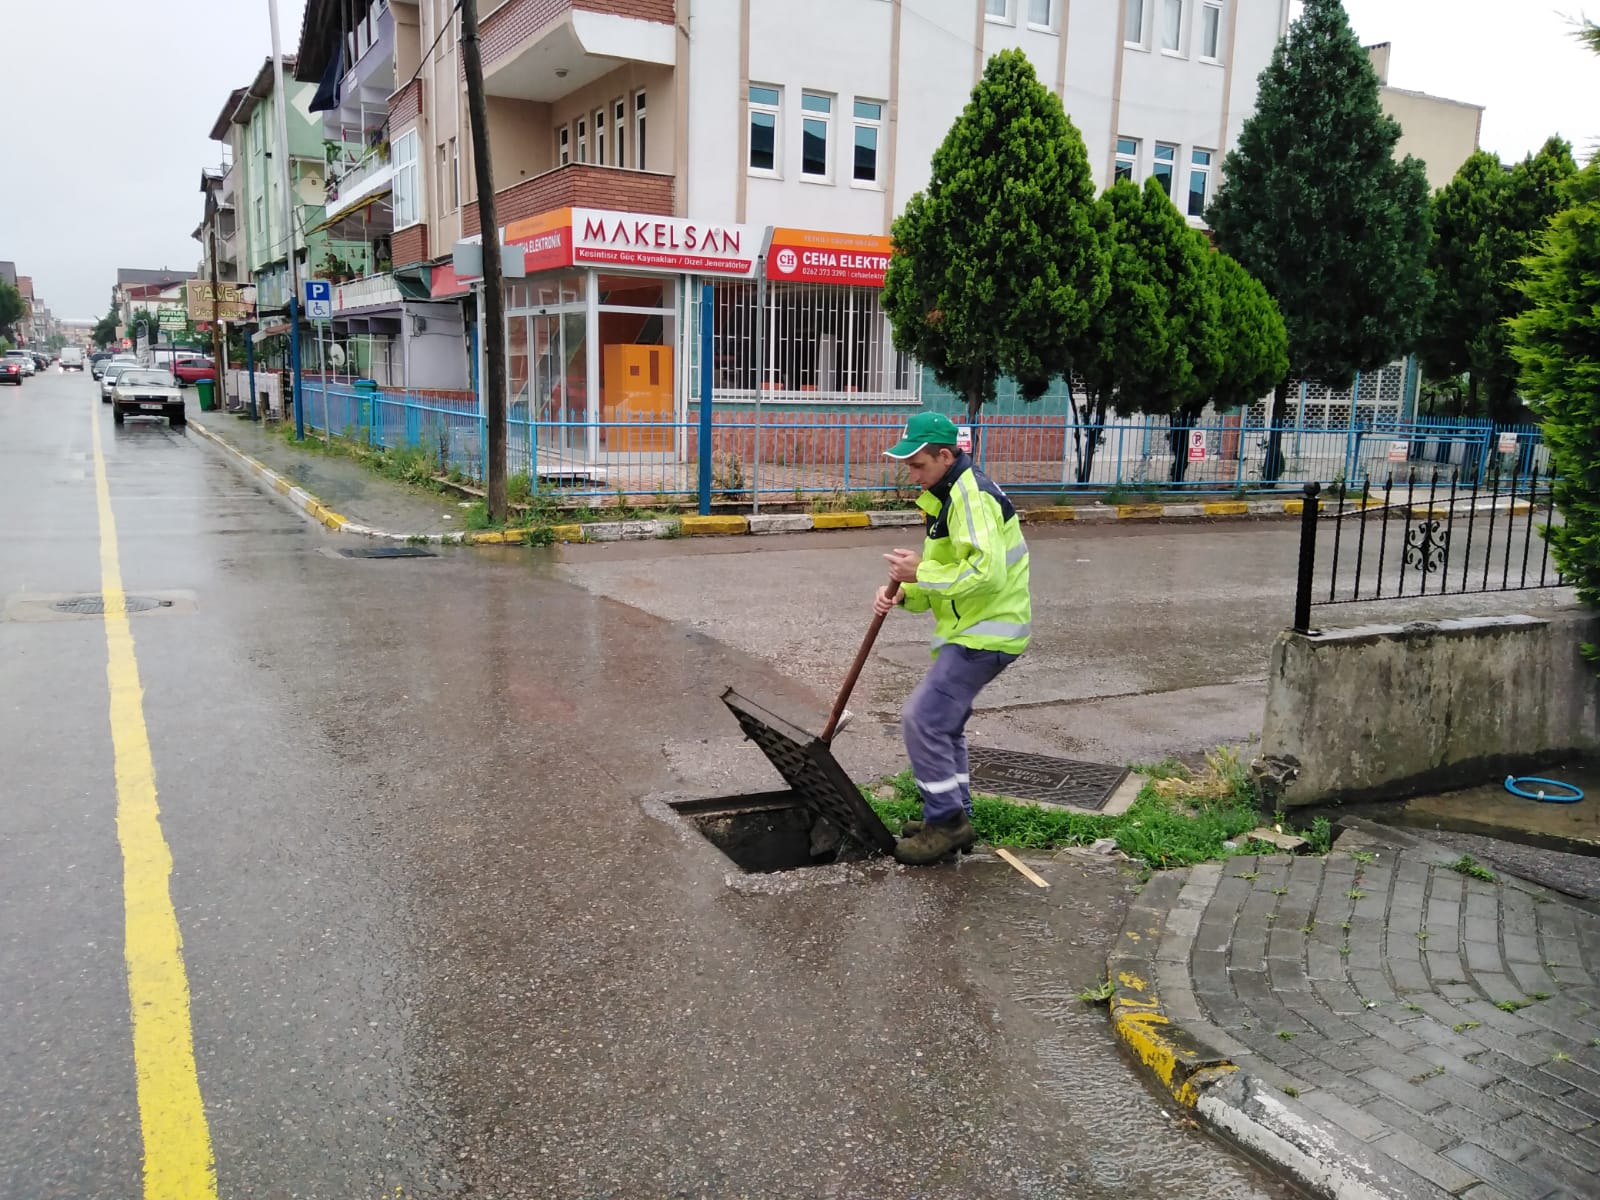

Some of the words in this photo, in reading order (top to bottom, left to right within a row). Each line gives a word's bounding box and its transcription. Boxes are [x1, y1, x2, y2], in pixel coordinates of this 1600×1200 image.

[583, 216, 741, 253] MAKELSAN
[579, 249, 618, 260] Kesintisiz
[779, 254, 795, 265] CH
[802, 252, 837, 267] CEHA
[312, 284, 324, 299] P
